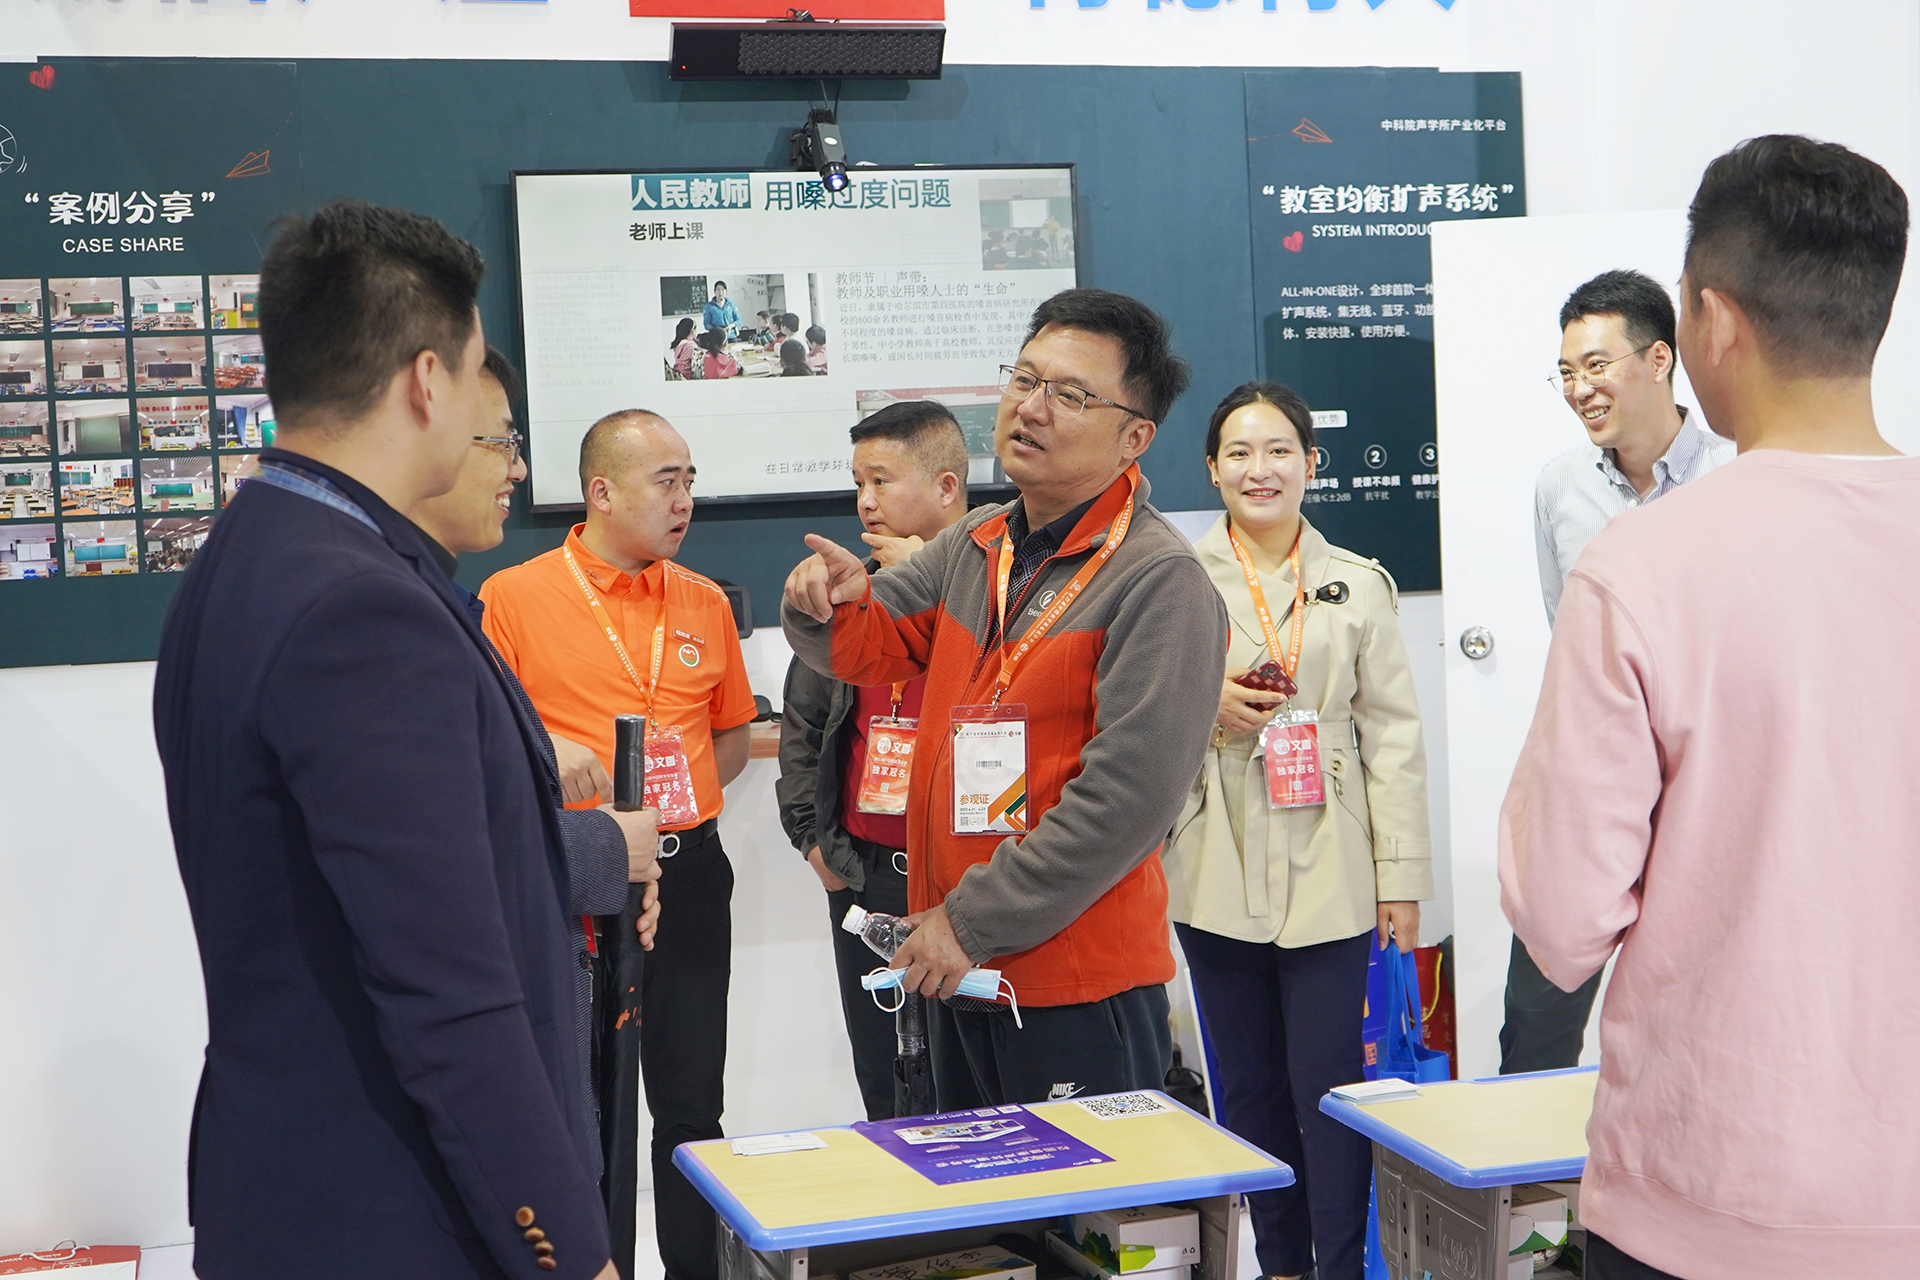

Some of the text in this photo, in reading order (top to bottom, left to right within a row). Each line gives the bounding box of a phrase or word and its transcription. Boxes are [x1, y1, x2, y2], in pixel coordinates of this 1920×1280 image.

[1381, 119, 1507, 131] 中科院声学所产业化平台
[632, 177, 952, 211] 人民教师 用嗓过度问题
[1262, 183, 1515, 214] “教室均衡扩声系统”
[24, 190, 216, 226] “案例分享”
[629, 222, 704, 241] 老师上课
[1312, 224, 1362, 237] SYSTEM
[62, 236, 185, 253] CASE SHARE
[835, 273, 874, 286] 教师节
[1370, 450, 1381, 463] 2
[1425, 448, 1436, 461] 3
[871, 765, 907, 779] 独家冠名
[1276, 764, 1315, 776] 独家冠名
[960, 794, 990, 806] 参观证
[1052, 1082, 1075, 1097] NIKE
